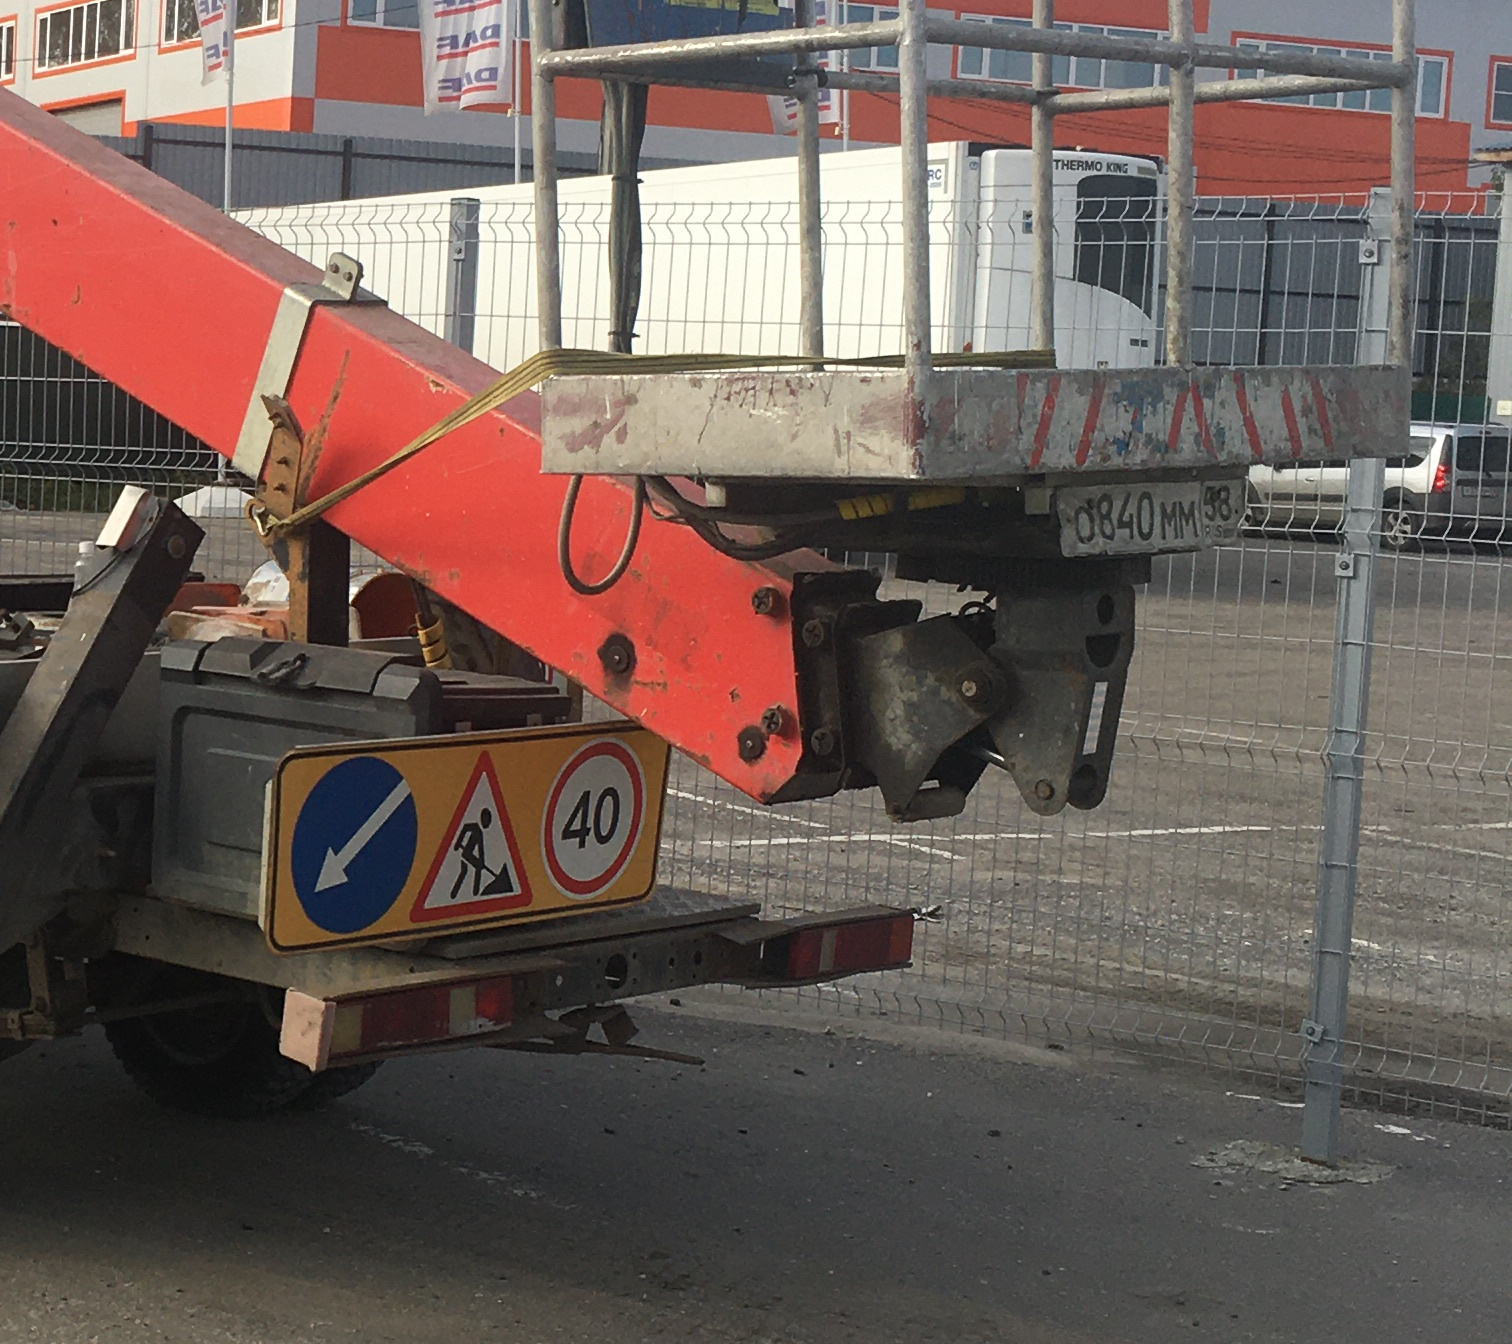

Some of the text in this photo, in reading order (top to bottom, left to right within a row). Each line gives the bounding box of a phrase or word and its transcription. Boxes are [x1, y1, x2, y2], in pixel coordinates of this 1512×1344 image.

[1053, 159, 1128, 174] THERMO KING
[561, 786, 620, 849] 40
